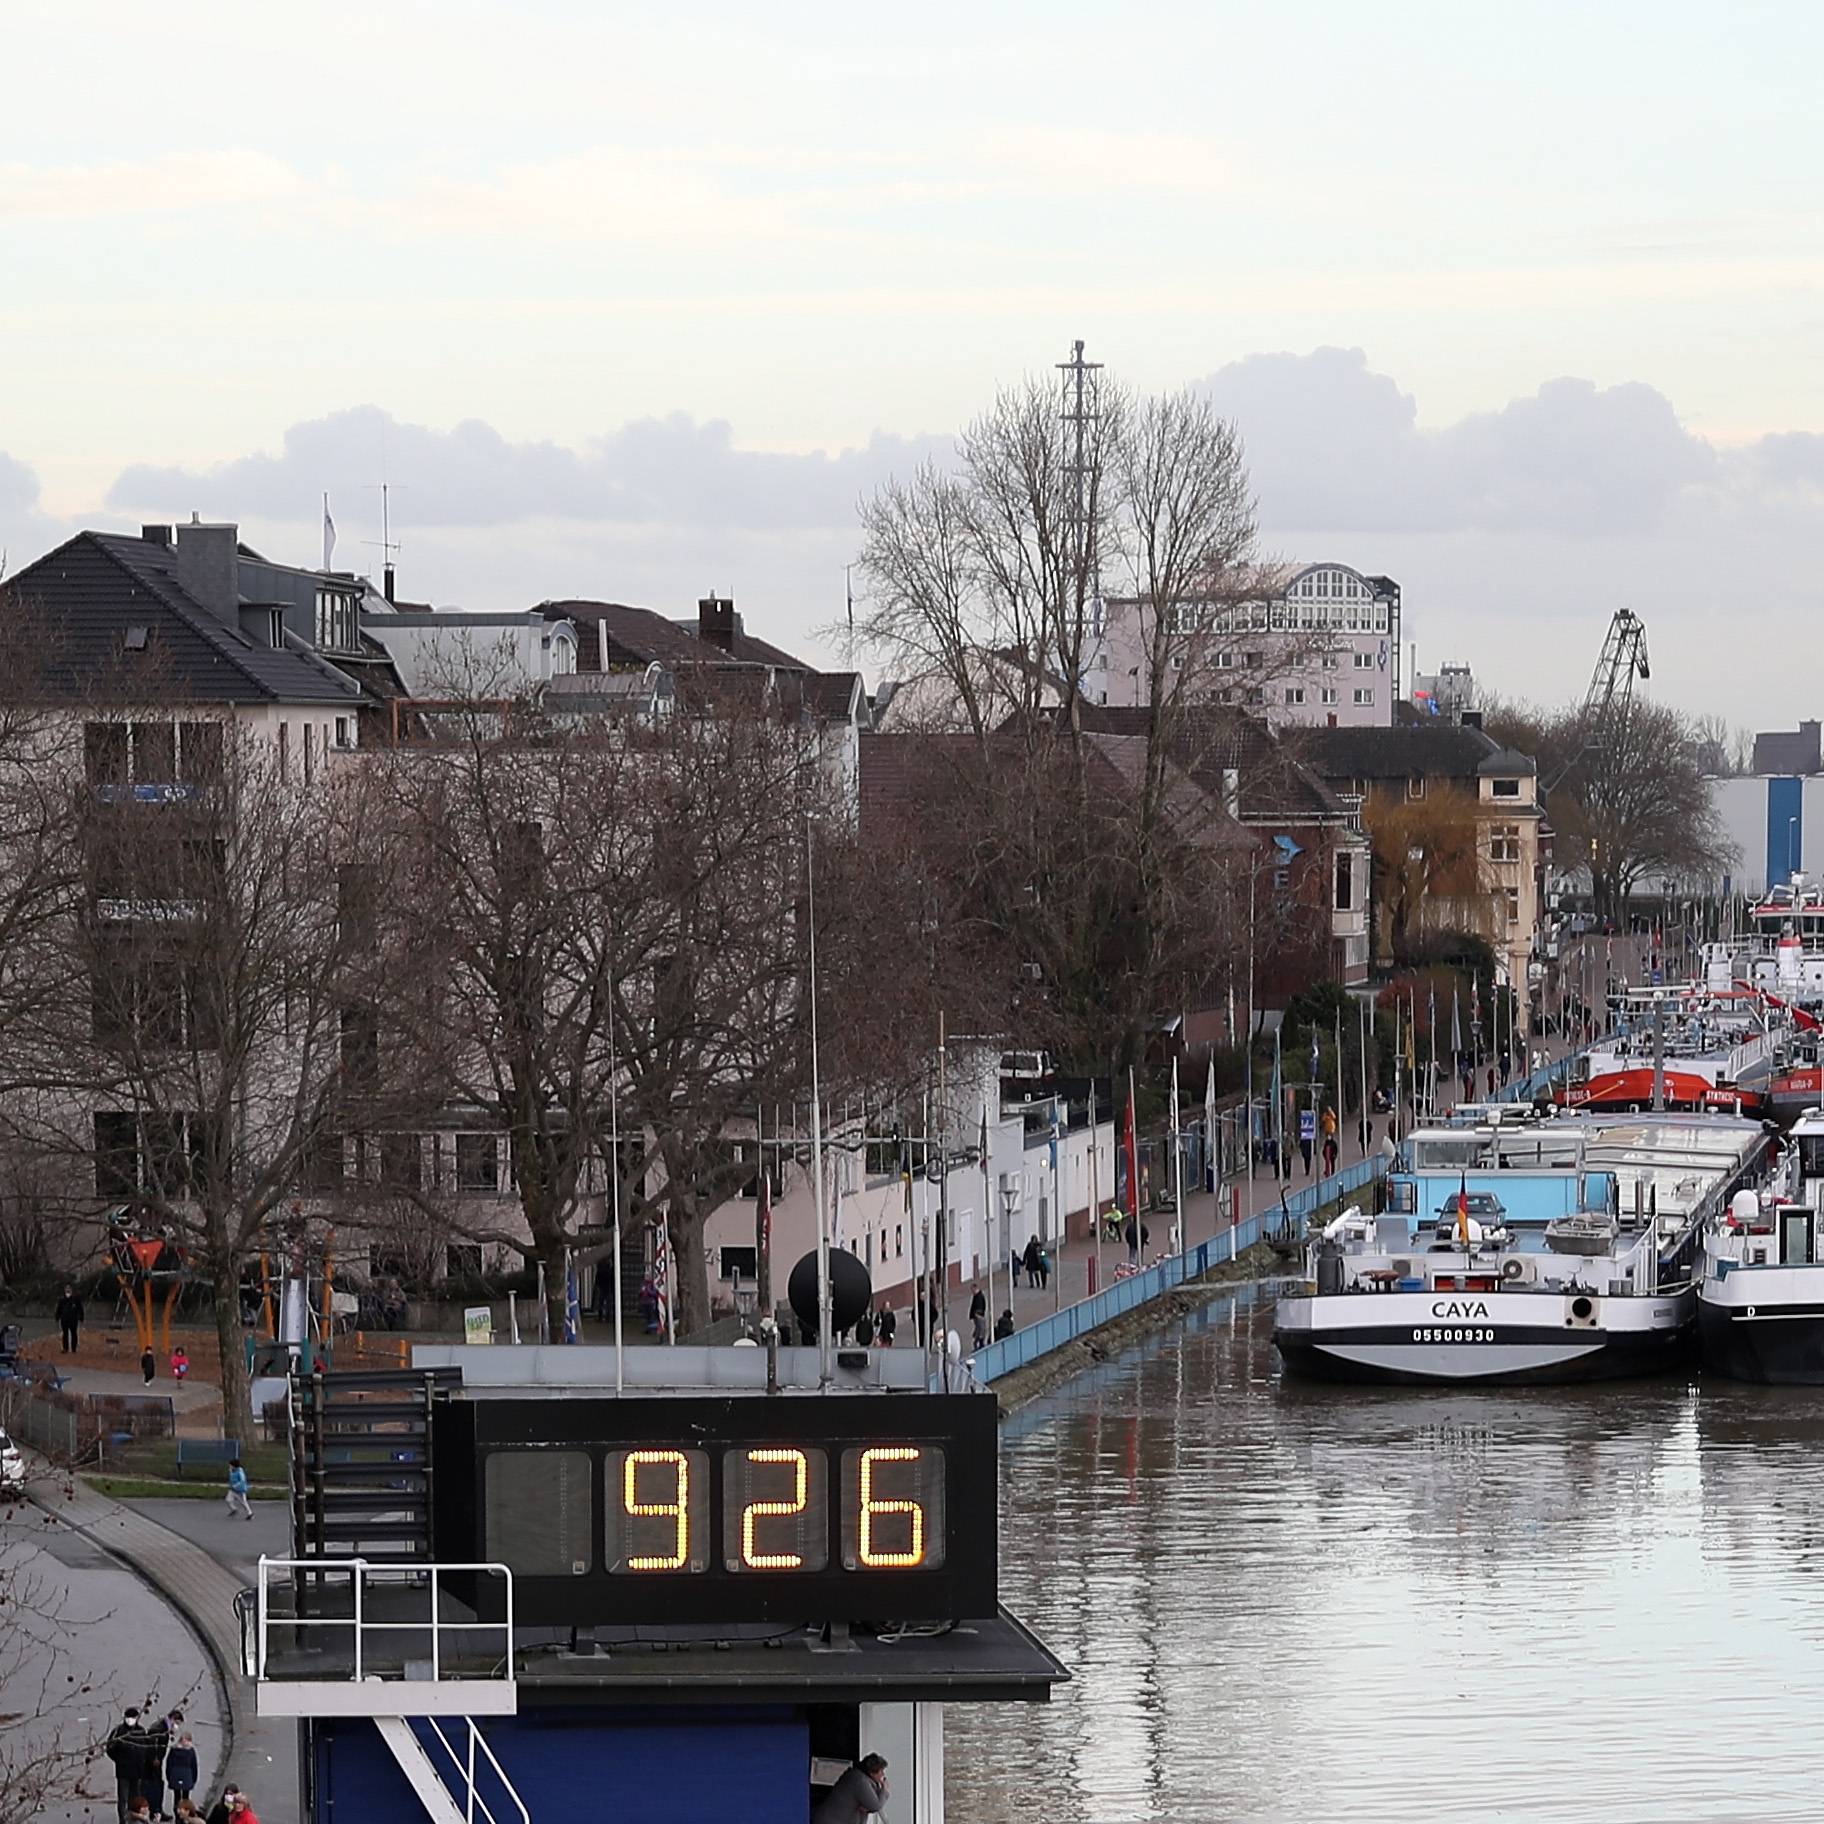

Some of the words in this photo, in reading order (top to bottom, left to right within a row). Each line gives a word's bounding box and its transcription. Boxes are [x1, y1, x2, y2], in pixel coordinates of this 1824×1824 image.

[1431, 1301, 1490, 1319] CAYA
[1747, 1306, 1756, 1317] D
[1412, 1328, 1495, 1342] 05500930
[623, 1447, 924, 1570] 926
